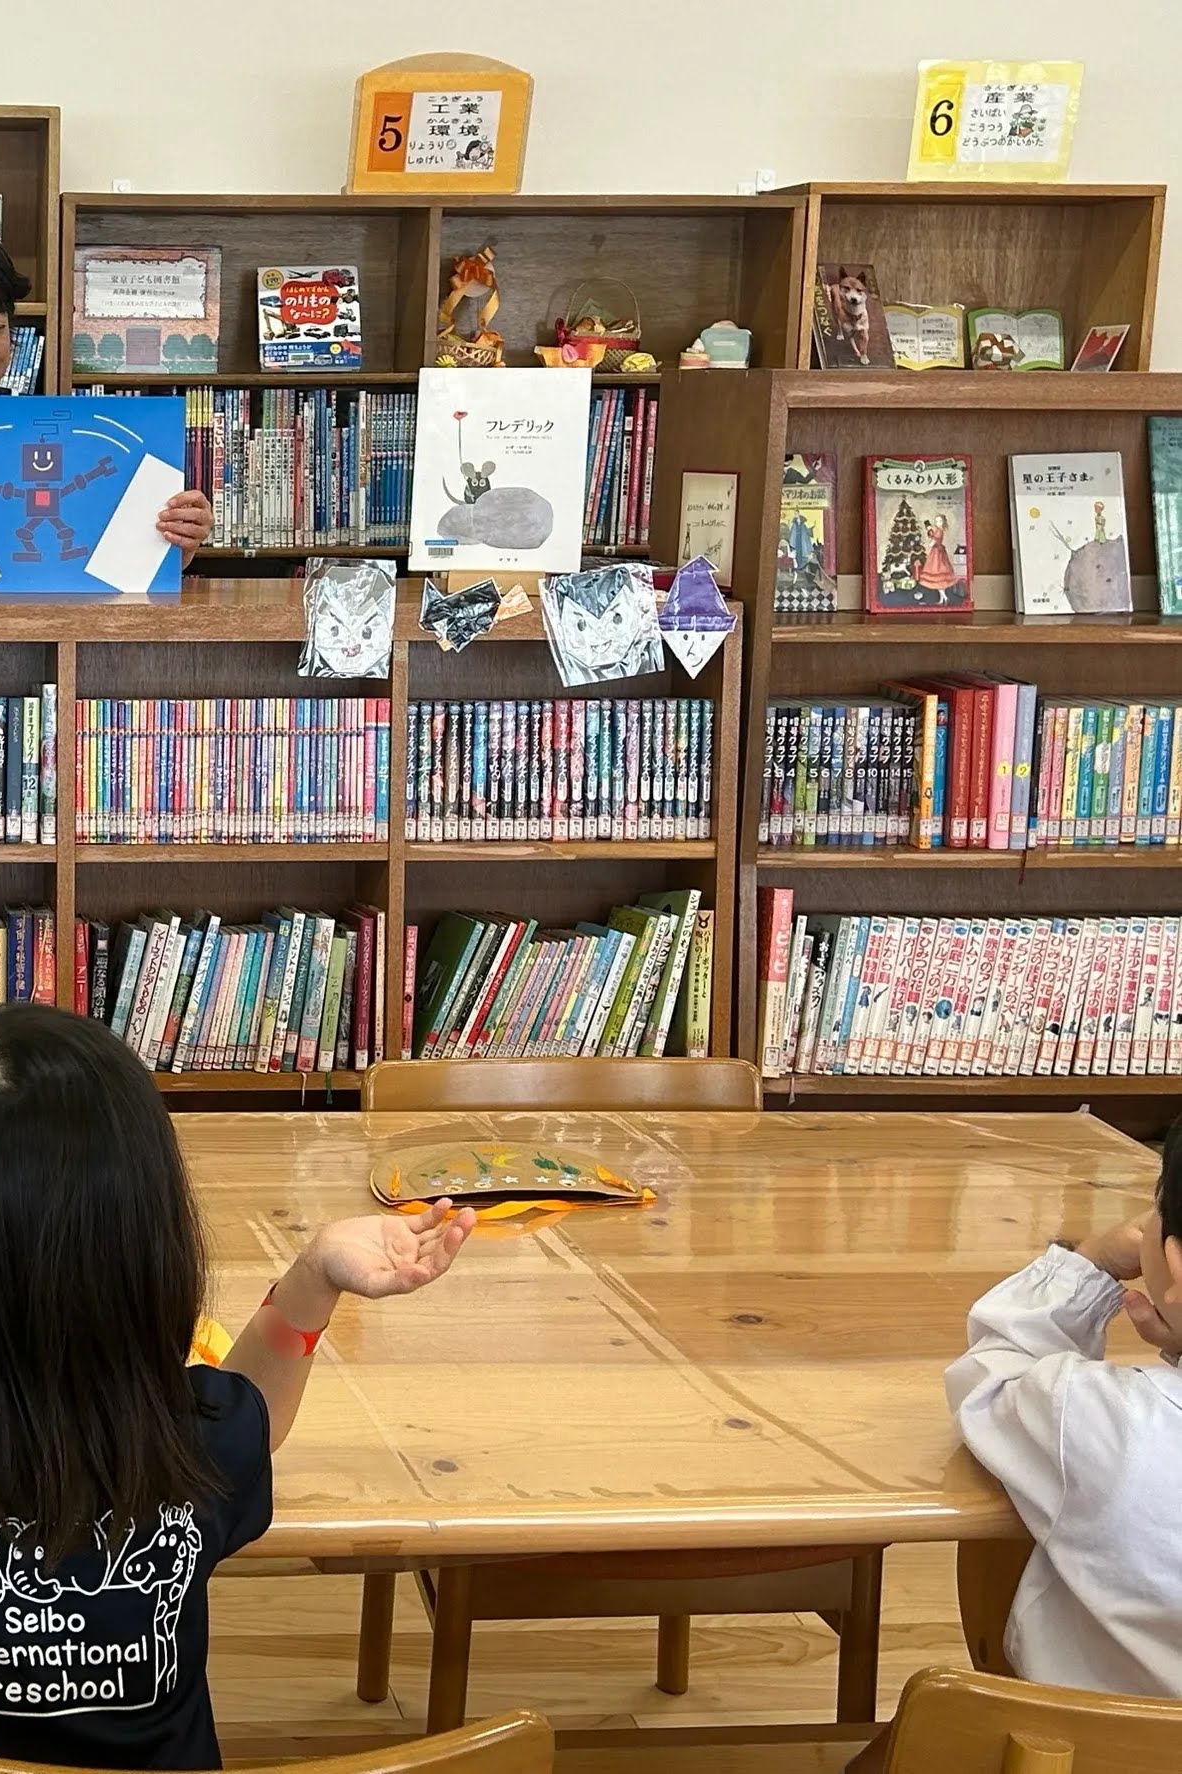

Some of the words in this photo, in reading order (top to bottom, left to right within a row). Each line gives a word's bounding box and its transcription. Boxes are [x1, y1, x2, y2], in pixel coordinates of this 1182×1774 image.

[428, 103, 480, 115] 工業
[984, 92, 1036, 104] 産業
[929, 99, 954, 136] 6
[970, 108, 1007, 118] さいばい
[378, 115, 403, 152] 5
[428, 125, 480, 136] 環境
[962, 136, 1045, 147] どうぶつのかいかた
[969, 123, 1003, 132] こうつう
[409, 141, 445, 150] りょうり
[407, 155, 443, 165] しゅげい
[111, 275, 180, 285] 東京子ども図書館
[285, 294, 331, 308] のりもの
[485, 418, 555, 433] フレデリック
[886, 472, 959, 485] くるみわり人形
[1022, 472, 1089, 484] 星の王子さま
[764, 717, 775, 764] 暗号クラブ
[776, 717, 787, 764] 暗号クラブ
[788, 717, 799, 764] 暗号クラブ
[822, 717, 833, 764] 暗号クラブ
[846, 717, 856, 764] 暗号クラブ
[869, 717, 880, 764] 暗号クラブ
[881, 717, 892, 764] 暗号クラブ
[892, 717, 903, 764] 暗号クラブ
[904, 717, 915, 764] 暗号クラブ
[23, 777, 36, 791] 12
[763, 769, 771, 777] 2
[787, 769, 795, 777] 4
[809, 769, 818, 777] 5
[821, 769, 830, 777] 6
[833, 769, 841, 777] 7
[845, 769, 853, 777] 8
[857, 769, 865, 777] 9
[868, 769, 877, 777] 10
[881, 769, 888, 777] 11
[891, 769, 900, 777] 14
[903, 769, 912, 777] 15
[674, 893, 697, 969] ジェインのもうふ
[694, 930, 703, 961] 呪いの子
[773, 930, 790, 974] ピッピ
[861, 935, 883, 984] 若草物語
[877, 934, 897, 985] たから島
[1143, 934, 1160, 985] 三国志
[889, 936, 917, 1011] ガリバー旅行記
[907, 936, 932, 1004] ひみつの花園
[923, 936, 951, 1010] アルプスの少女
[975, 937, 999, 995] 赤毛のアン
[995, 937, 1017, 987] 家なき子
[1003, 936, 1031, 1016] フランダースの犬
[1037, 935, 1063, 1009] ひみつの花園
[1121, 936, 1143, 1015] 十五少年漂流記
[1156, 935, 1175, 1012] ドラキュラ物語
[76, 966, 86, 993] アニー
[5, 1606, 86, 1634] Seibo
